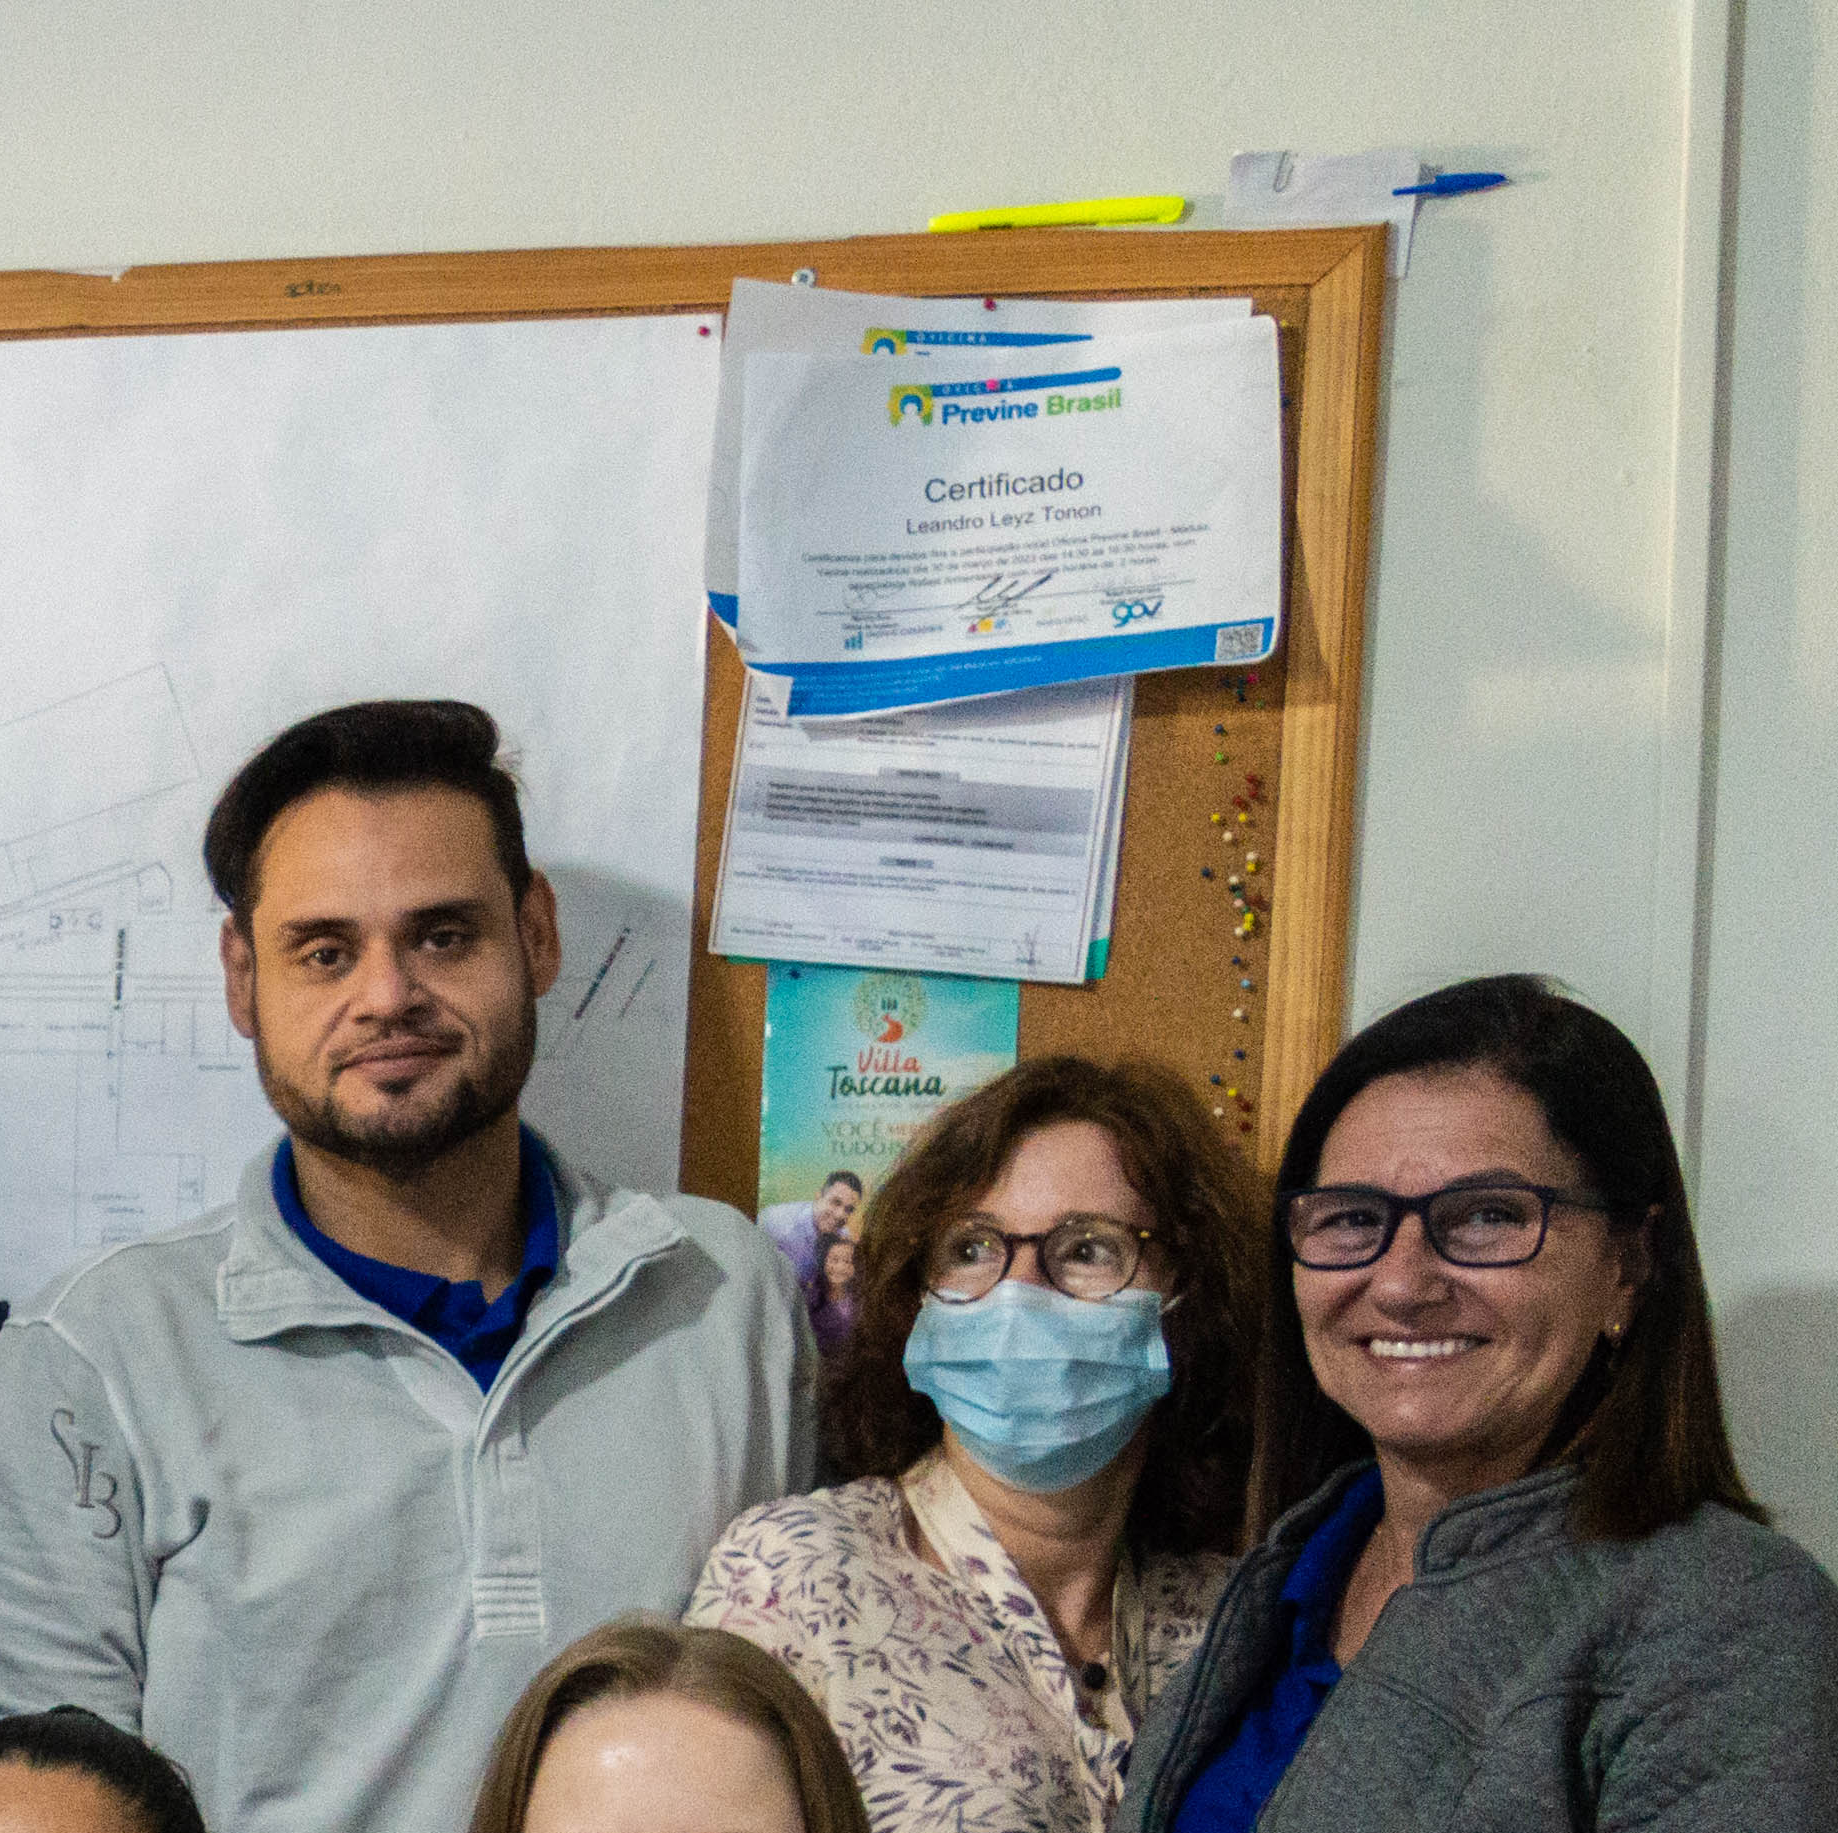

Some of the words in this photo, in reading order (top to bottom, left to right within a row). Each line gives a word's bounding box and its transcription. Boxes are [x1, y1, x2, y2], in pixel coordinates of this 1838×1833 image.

[942, 400, 1038, 425] Previne
[1046, 388, 1122, 416] Brasil
[924, 467, 1084, 503] Certificado
[906, 515, 984, 535] Leandro
[1043, 503, 1102, 523] Tonon
[857, 1047, 922, 1073] Villa
[826, 1064, 946, 1099] Toscana
